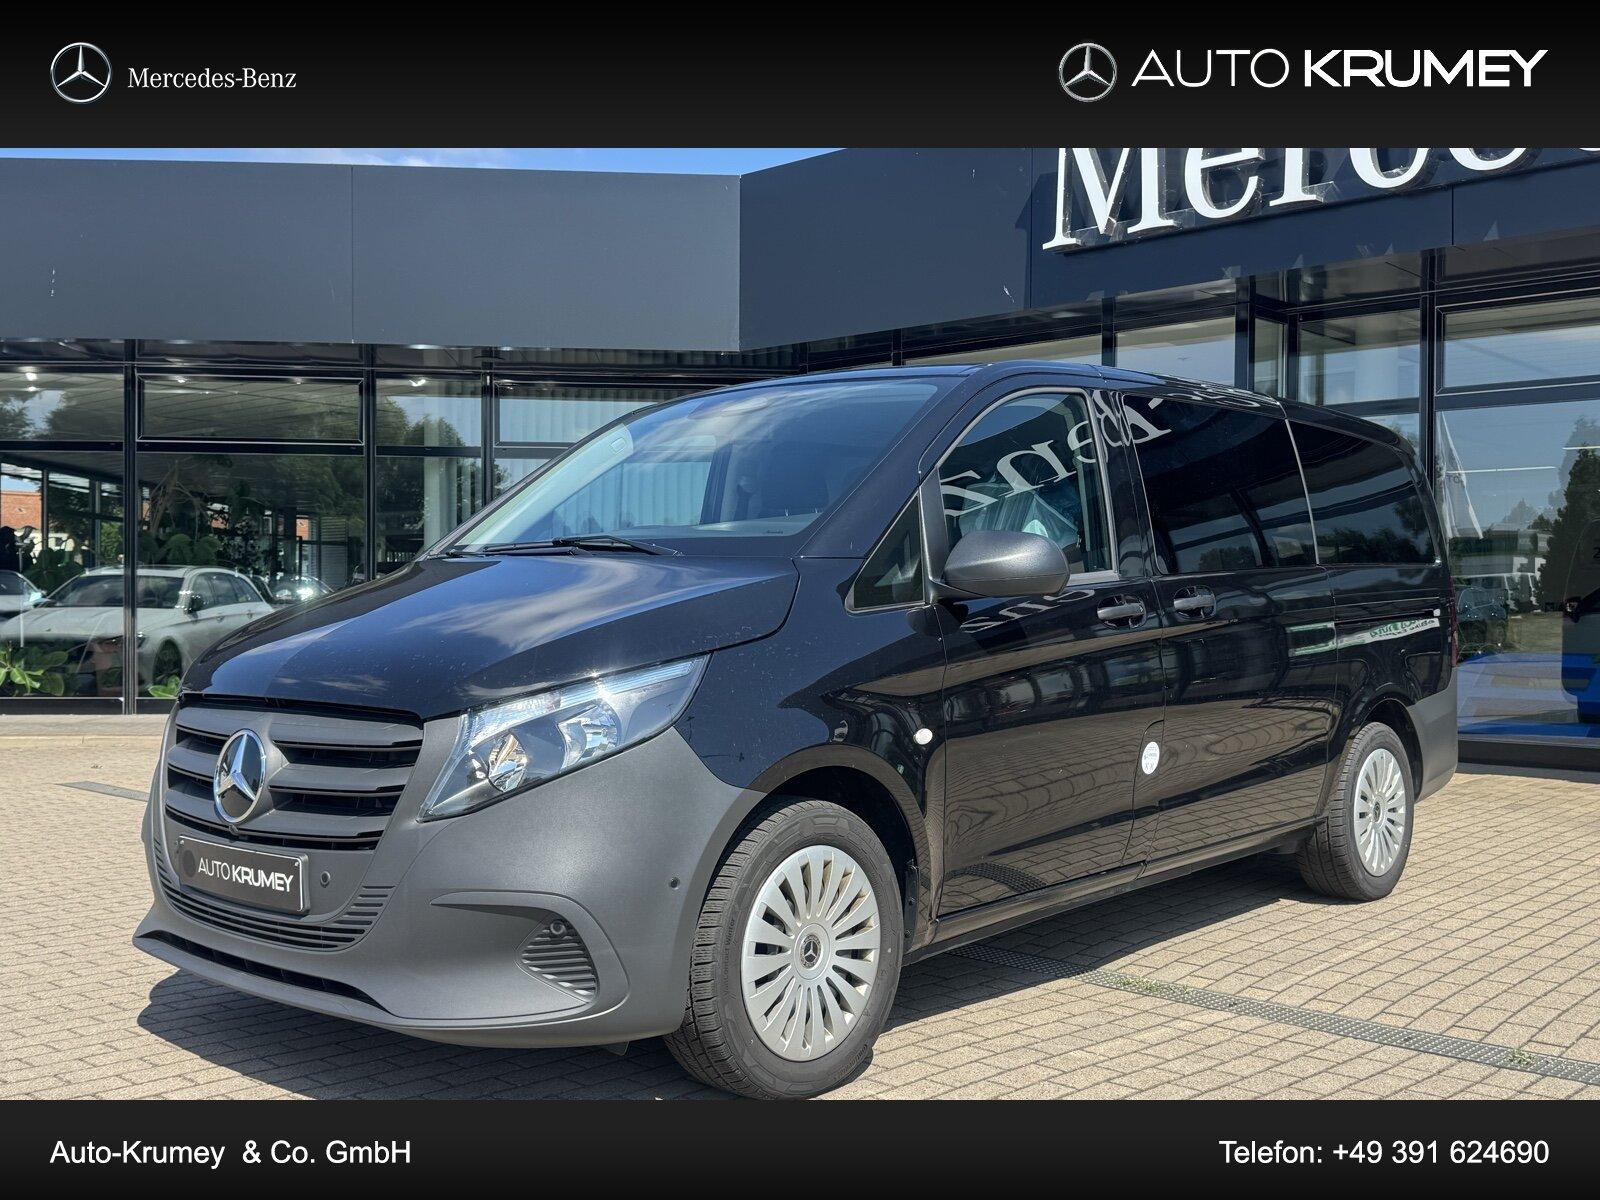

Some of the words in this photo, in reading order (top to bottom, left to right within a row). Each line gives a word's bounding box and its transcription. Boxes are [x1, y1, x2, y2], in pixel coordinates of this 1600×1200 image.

[1043, 147, 1600, 251] Merc
[198, 858, 231, 881] AUTO
[232, 865, 294, 892] KRUMEY
